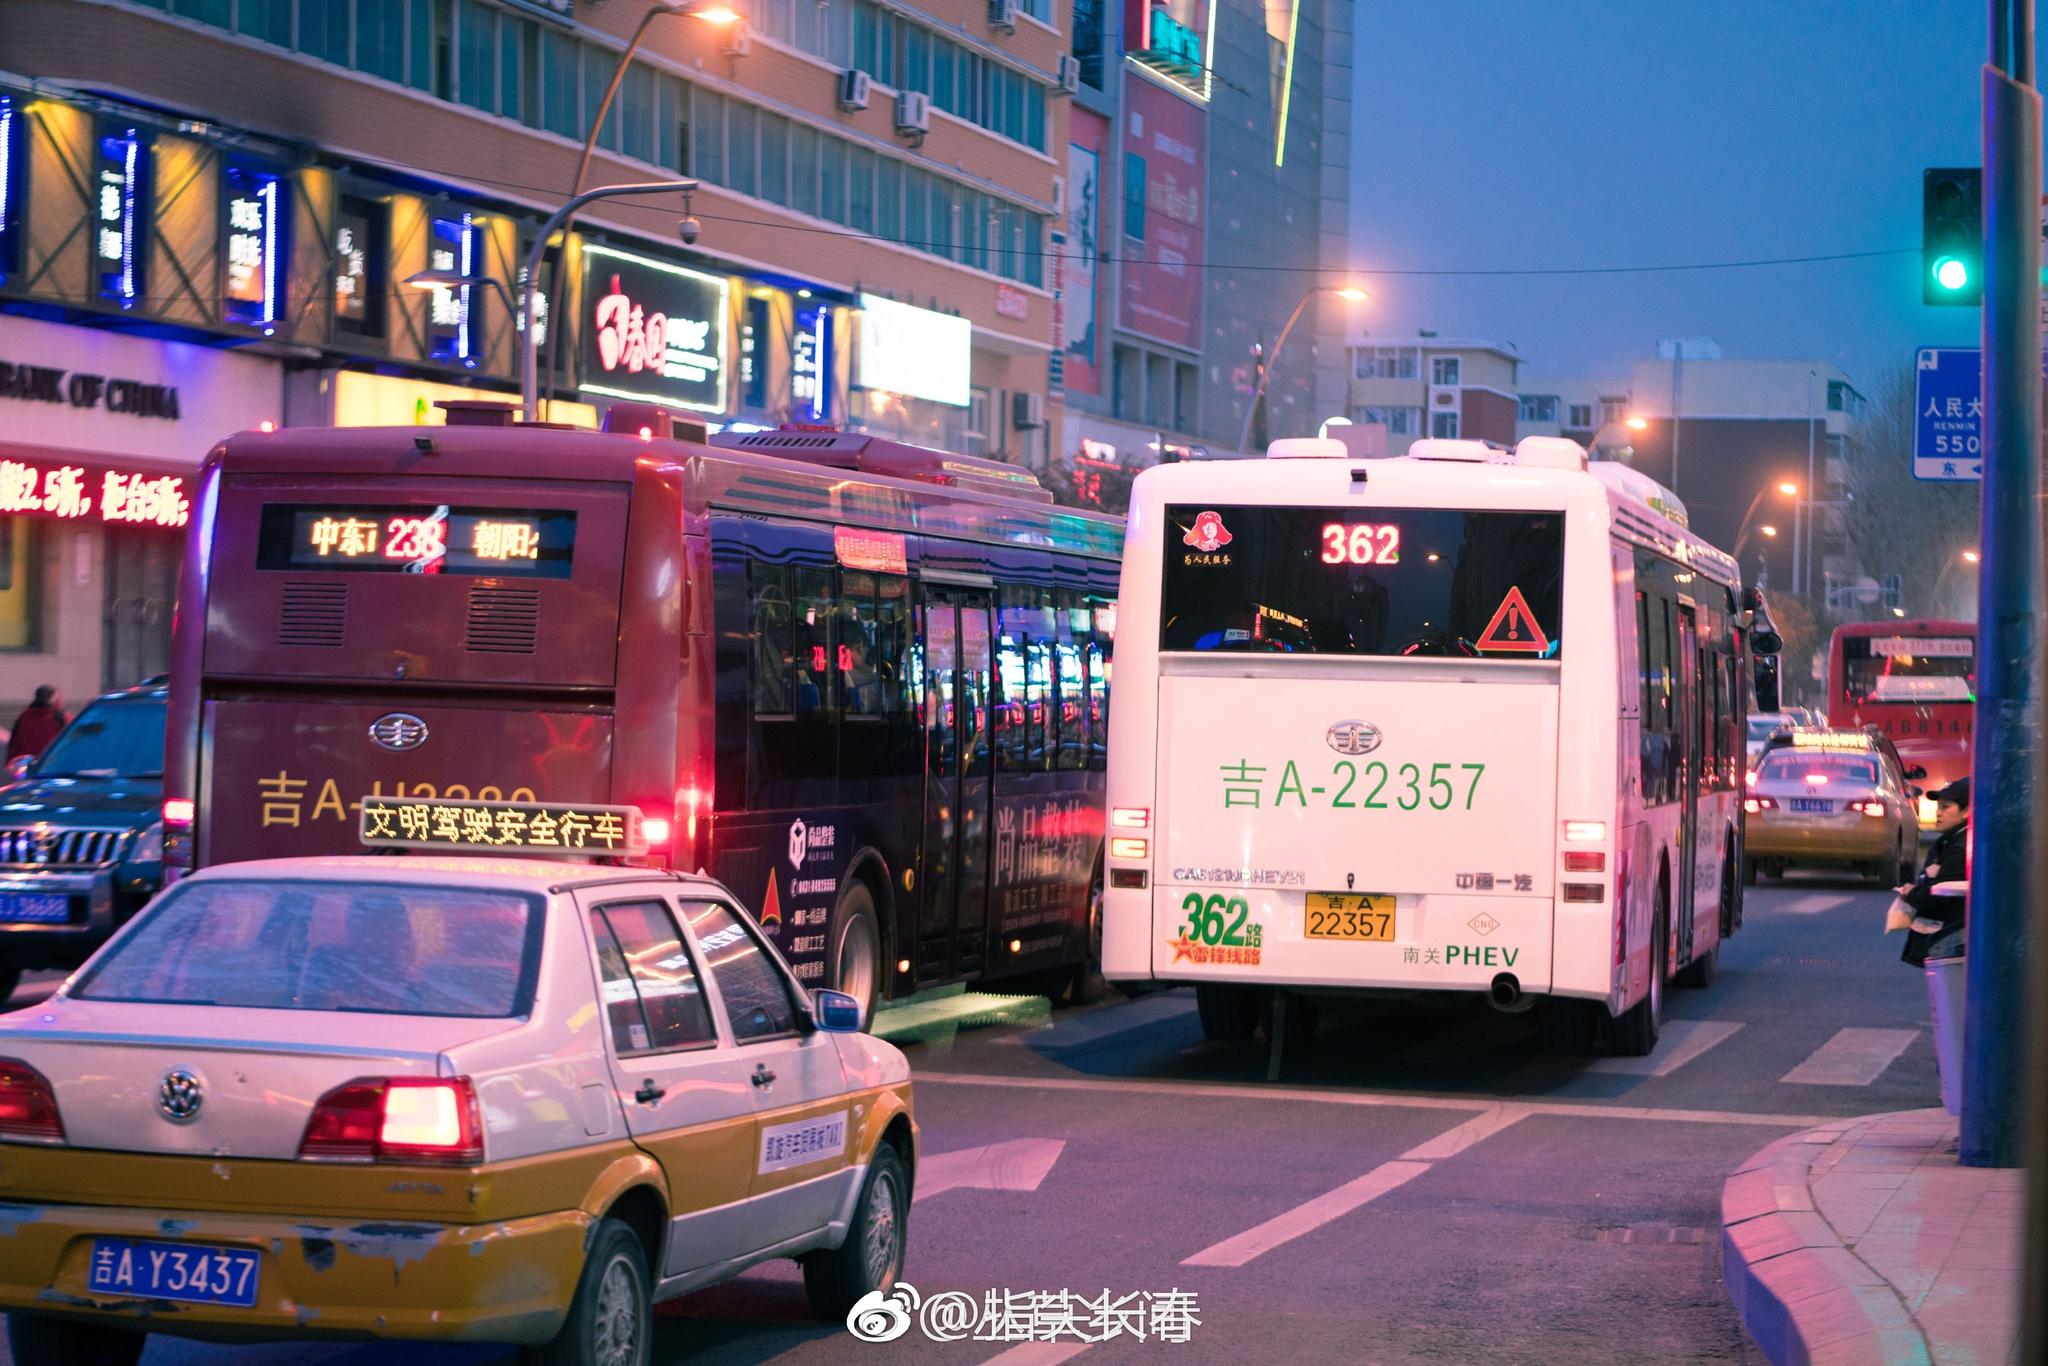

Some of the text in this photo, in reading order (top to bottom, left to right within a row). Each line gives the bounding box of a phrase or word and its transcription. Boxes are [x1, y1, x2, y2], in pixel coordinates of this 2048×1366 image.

[69, 373, 104, 408] OF
[106, 378, 182, 421] CHINA
[1934, 421, 1976, 431] RENMIN
[1322, 524, 1400, 564] 362
[1184, 554, 1232, 566] 为人民服务
[1220, 758, 1486, 811] 吉A-22357
[365, 802, 624, 850] 文明驾驶安全行车
[1456, 872, 1533, 892] 中国一汽
[1310, 911, 1391, 937] 22357
[1473, 919, 1495, 930] CNG
[1193, 946, 1262, 965] 雷锋线路
[1403, 945, 1519, 967] 南关 PHEV
[94, 1246, 255, 1297] 吉A·Y3437
